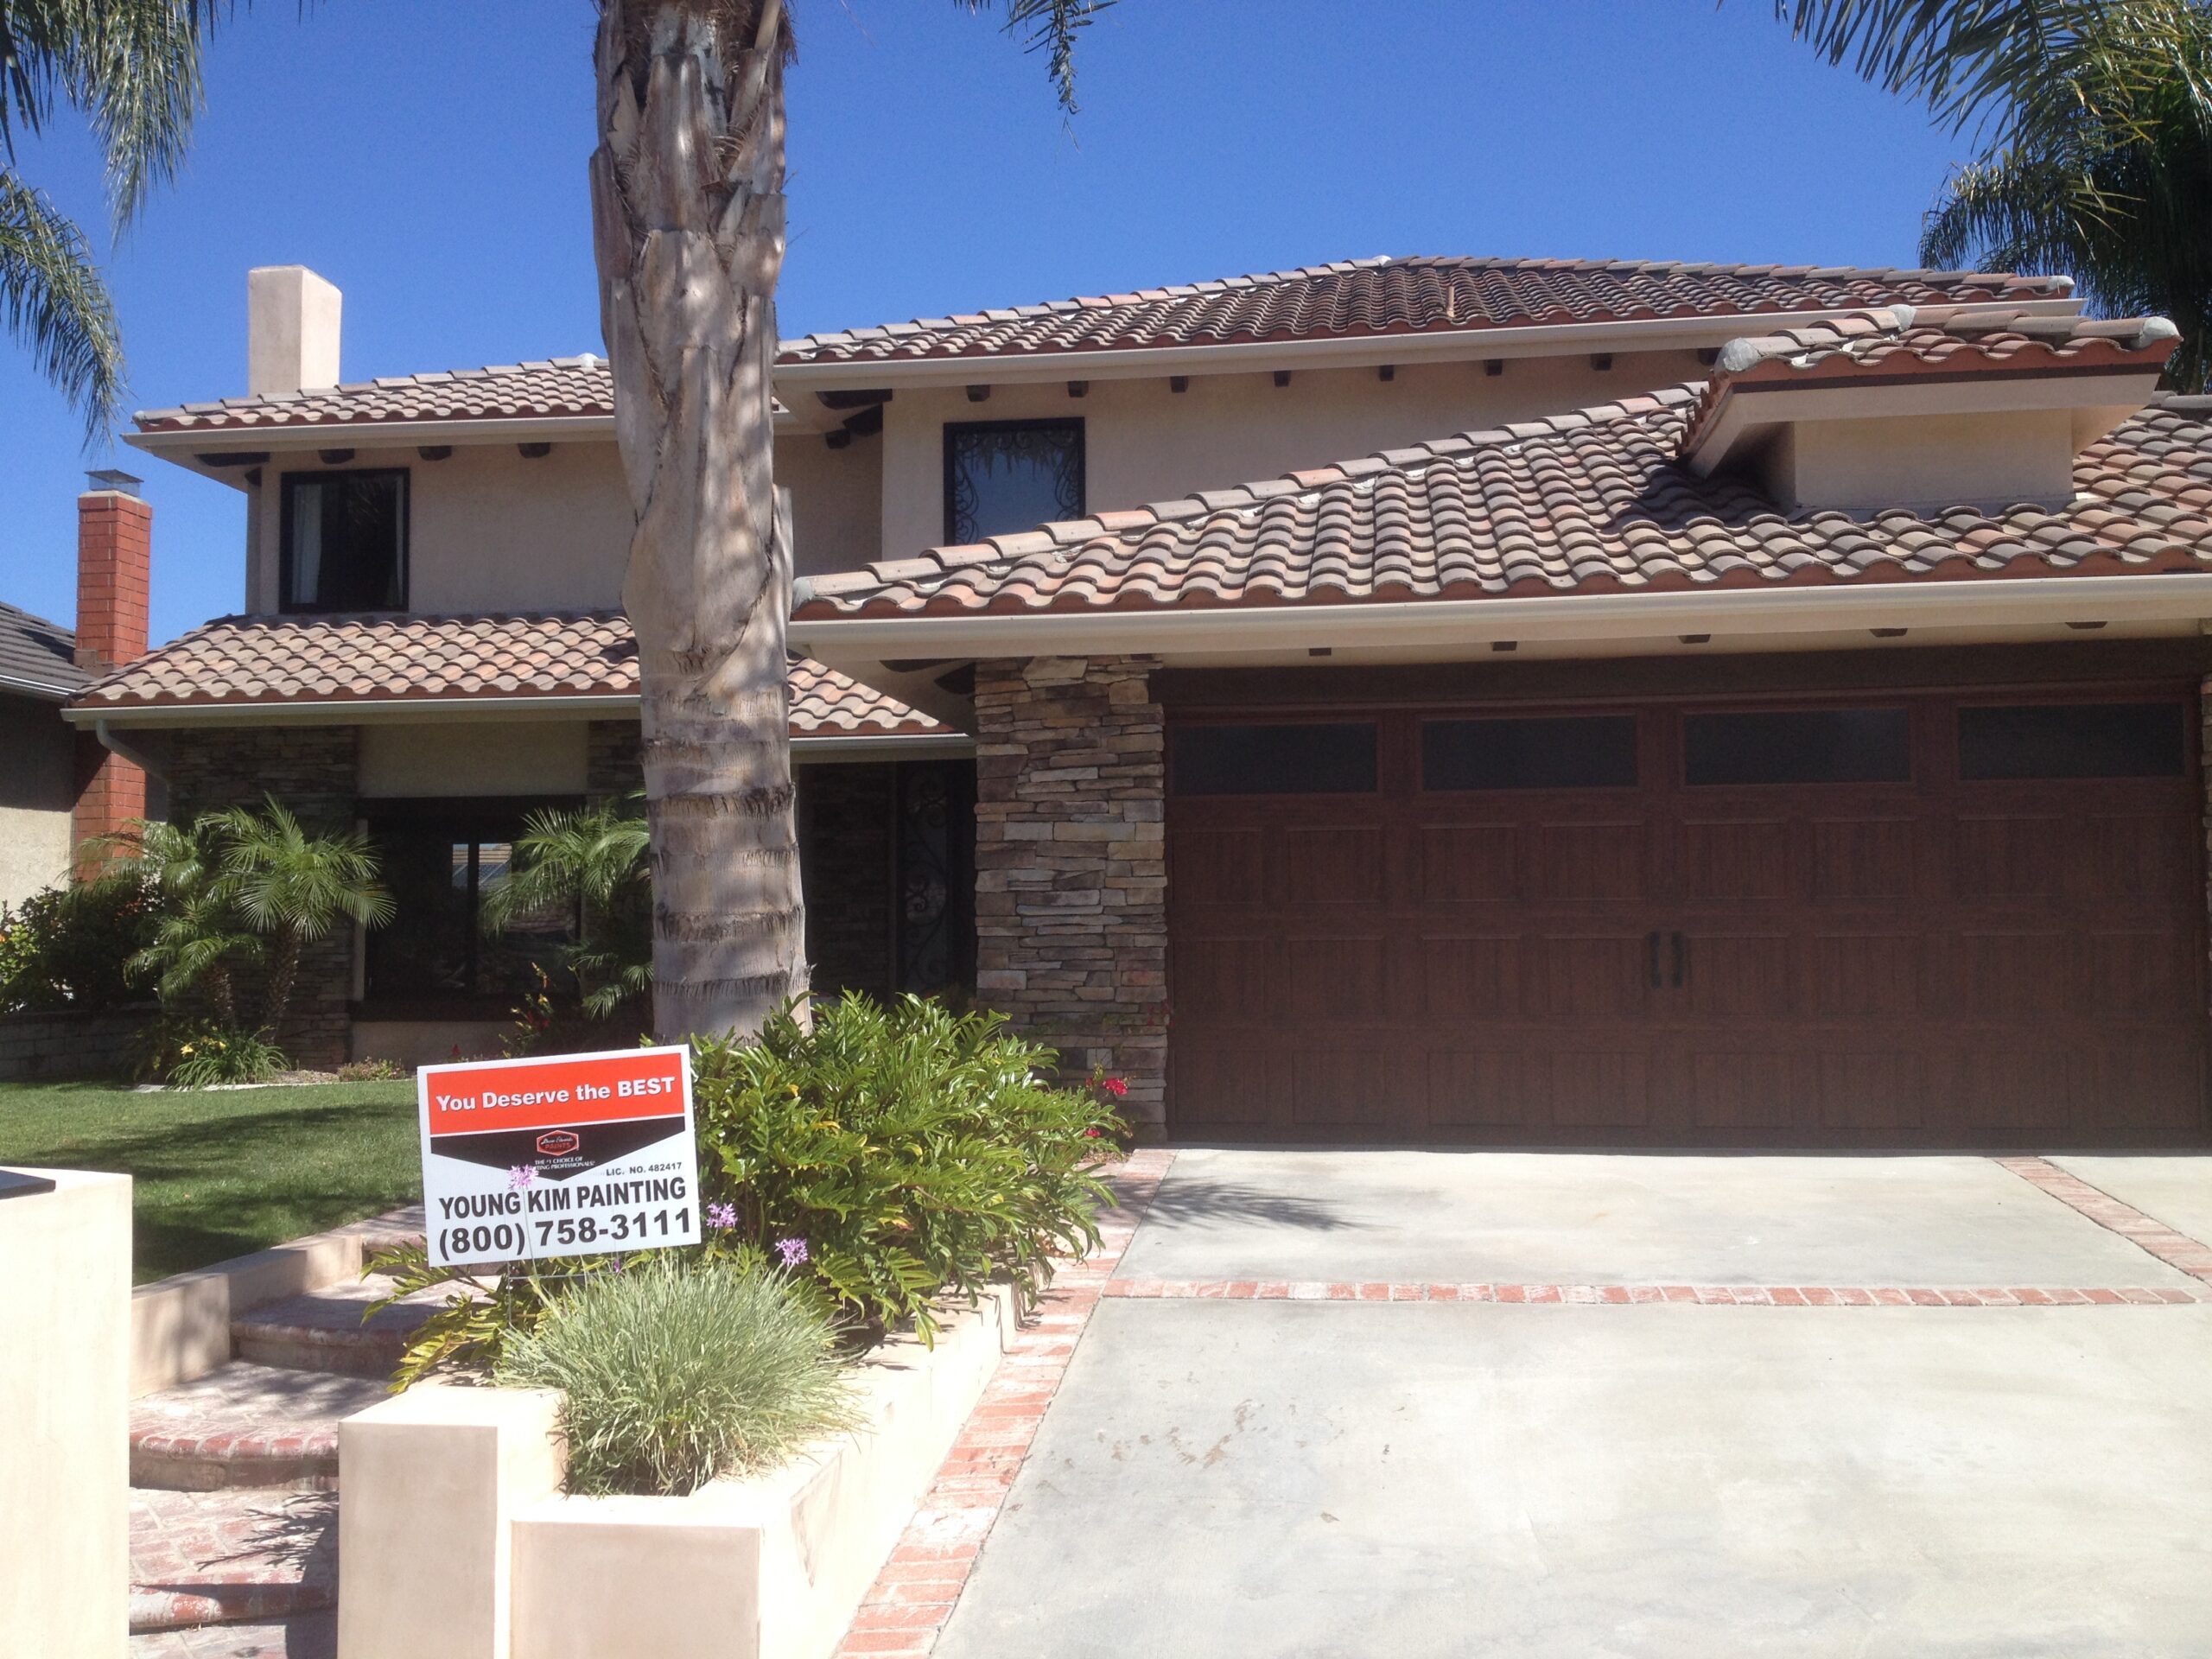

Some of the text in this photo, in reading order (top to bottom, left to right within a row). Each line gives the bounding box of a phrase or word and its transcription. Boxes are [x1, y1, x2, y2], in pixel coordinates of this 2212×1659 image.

[435, 1077, 676, 1112] You Deserve the BEST
[606, 1161, 683, 1176] LIC. NO. 482417
[438, 1177, 687, 1220] YOUNG KIM PAINTING
[439, 1207, 690, 1262] (800) 758-3111
